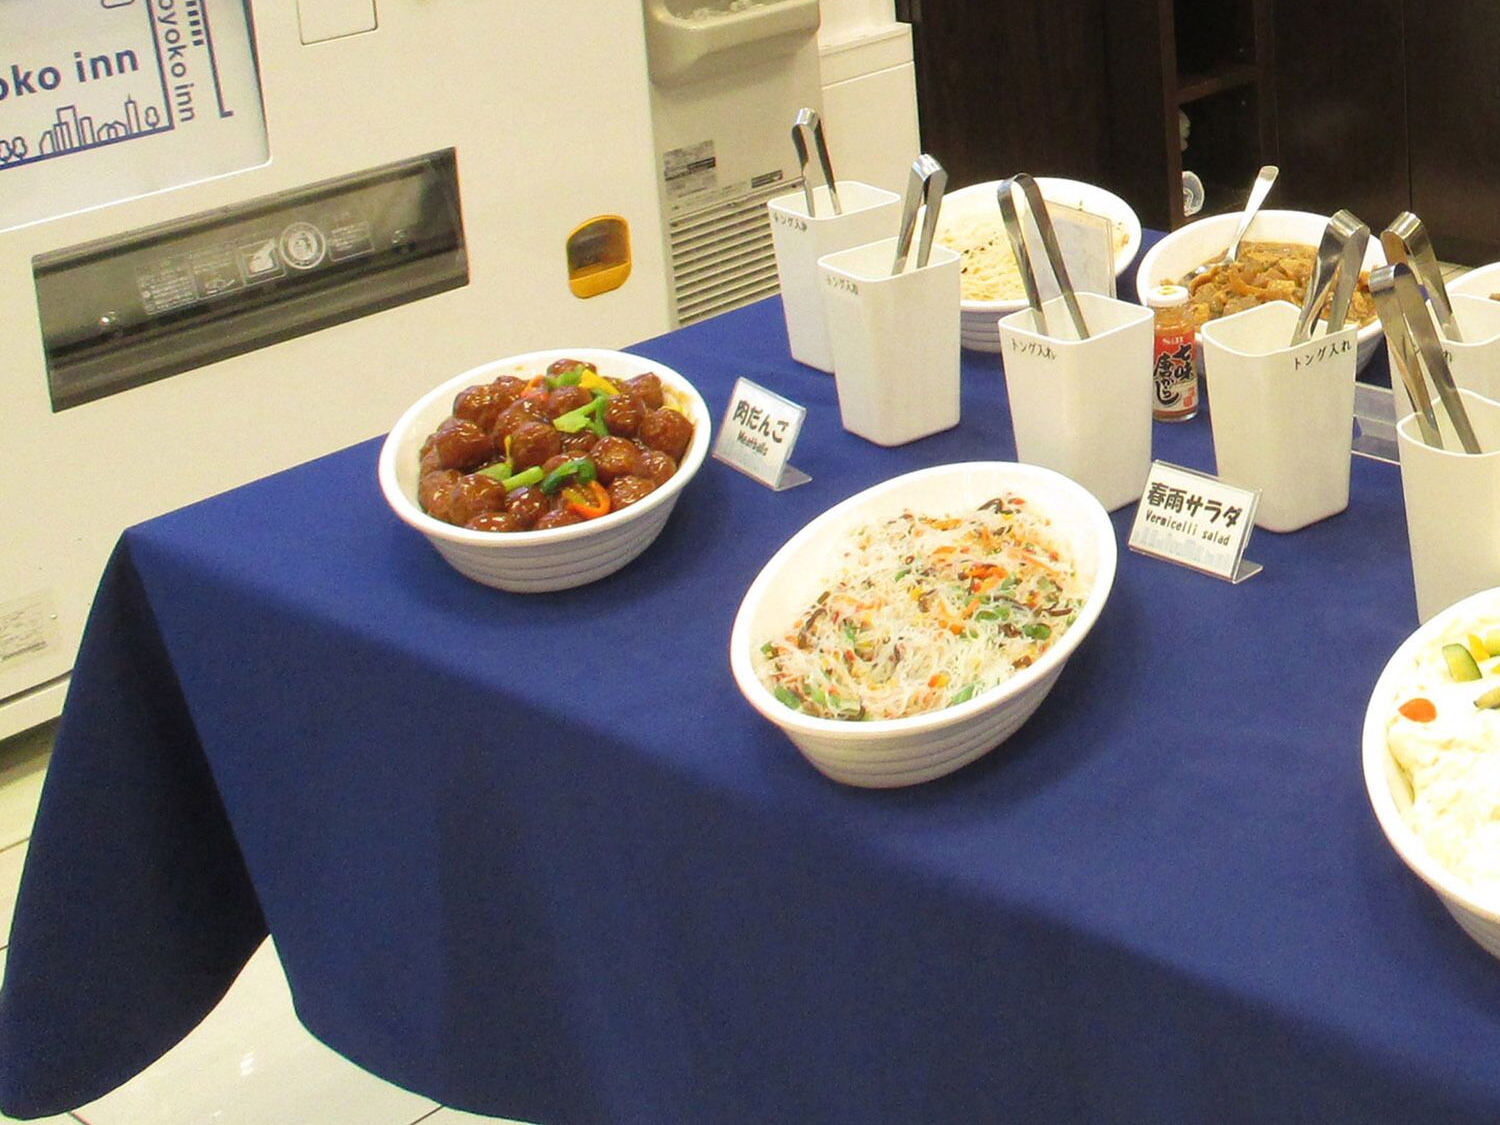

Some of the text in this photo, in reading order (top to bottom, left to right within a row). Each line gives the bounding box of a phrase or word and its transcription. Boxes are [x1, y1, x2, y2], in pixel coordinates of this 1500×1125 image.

[73, 49, 139, 83] inn
[174, 82, 195, 123] inn
[1010, 336, 1058, 363] トング入れ
[1294, 340, 1352, 371] トング入れ
[733, 400, 789, 444] 肉だんご
[737, 430, 768, 456] Meatballs
[1147, 481, 1242, 529] 春雨サラダ
[1145, 508, 1231, 546] Vermicelli salad
